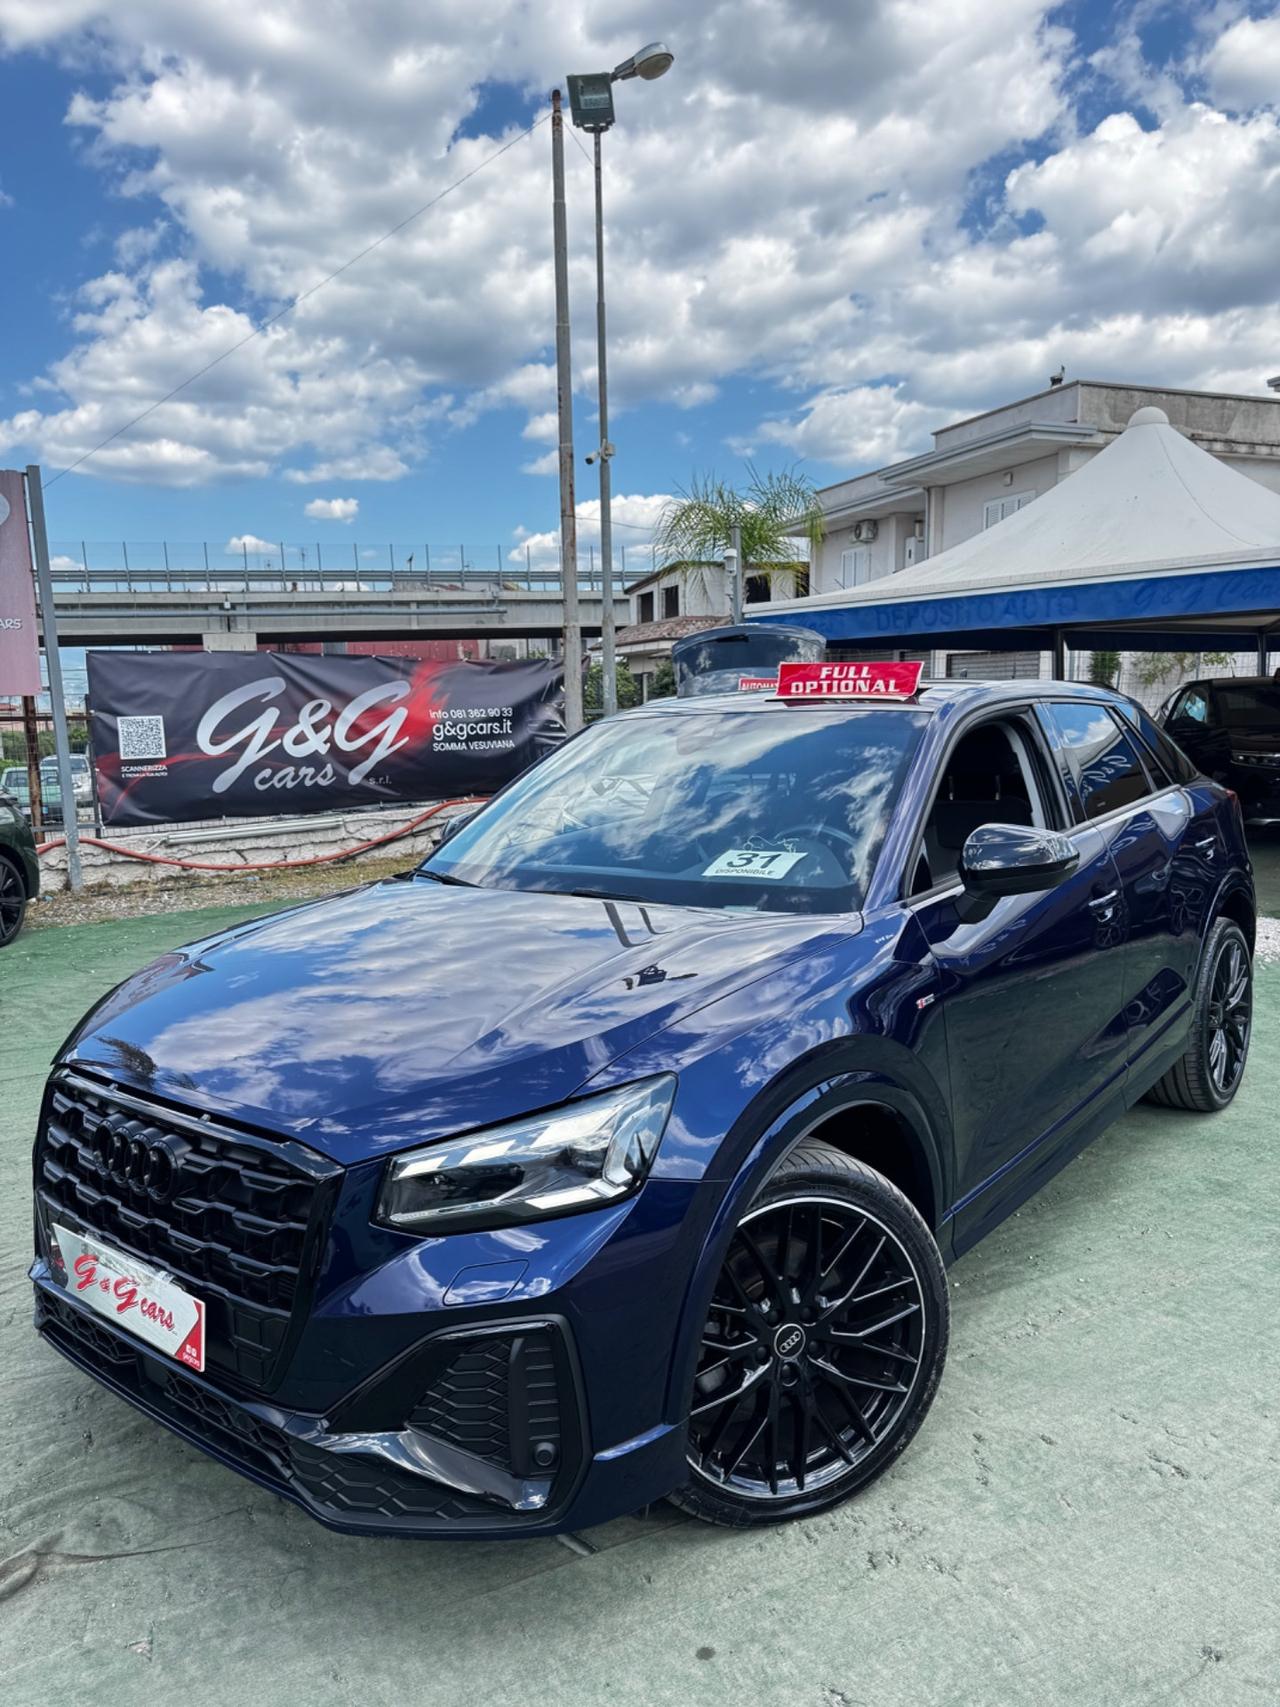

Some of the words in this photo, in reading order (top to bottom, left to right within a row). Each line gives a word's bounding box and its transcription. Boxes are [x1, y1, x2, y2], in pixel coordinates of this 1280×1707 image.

[1002, 591, 1078, 620] AUTO
[820, 666, 872, 679] FULL
[790, 680, 900, 694] OPTIONAL
[450, 708, 467, 719] 081
[468, 707, 486, 718] 362
[487, 708, 500, 717] 90
[501, 707, 513, 717] 33
[197, 676, 411, 793] G&G
[432, 719, 513, 740] g&gcars.it
[433, 741, 467, 752] SOMMA
[468, 740, 515, 750] VESUVIANA
[254, 763, 336, 791] cars
[368, 774, 392, 785] s.r.l.
[726, 852, 782, 869] 31
[715, 867, 775, 876] DISPONIBILE
